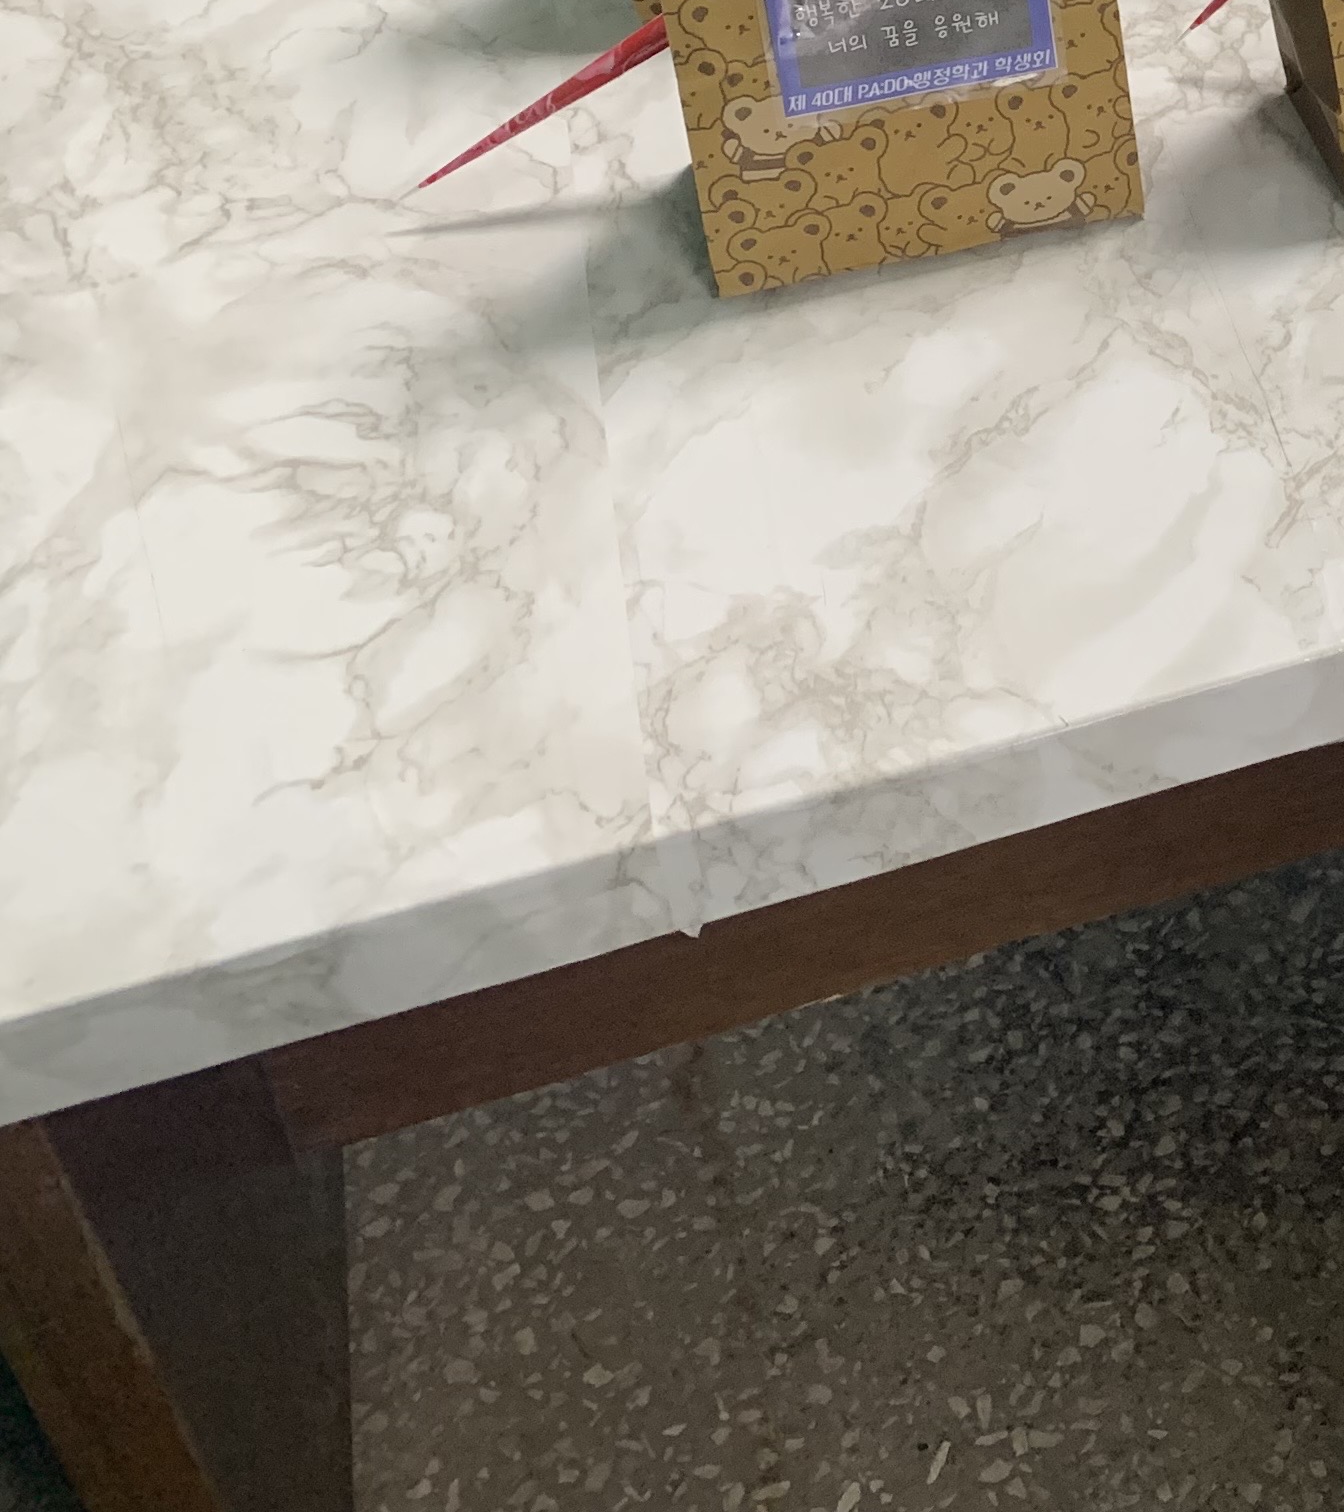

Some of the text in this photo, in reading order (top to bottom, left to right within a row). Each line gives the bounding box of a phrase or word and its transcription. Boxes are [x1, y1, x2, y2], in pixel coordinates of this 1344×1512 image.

[828, 10, 1000, 55] 너의 꿈을 응원해
[787, 91, 806, 113] 제
[811, 84, 853, 107] 40대
[994, 48, 1052, 74] 학생회
